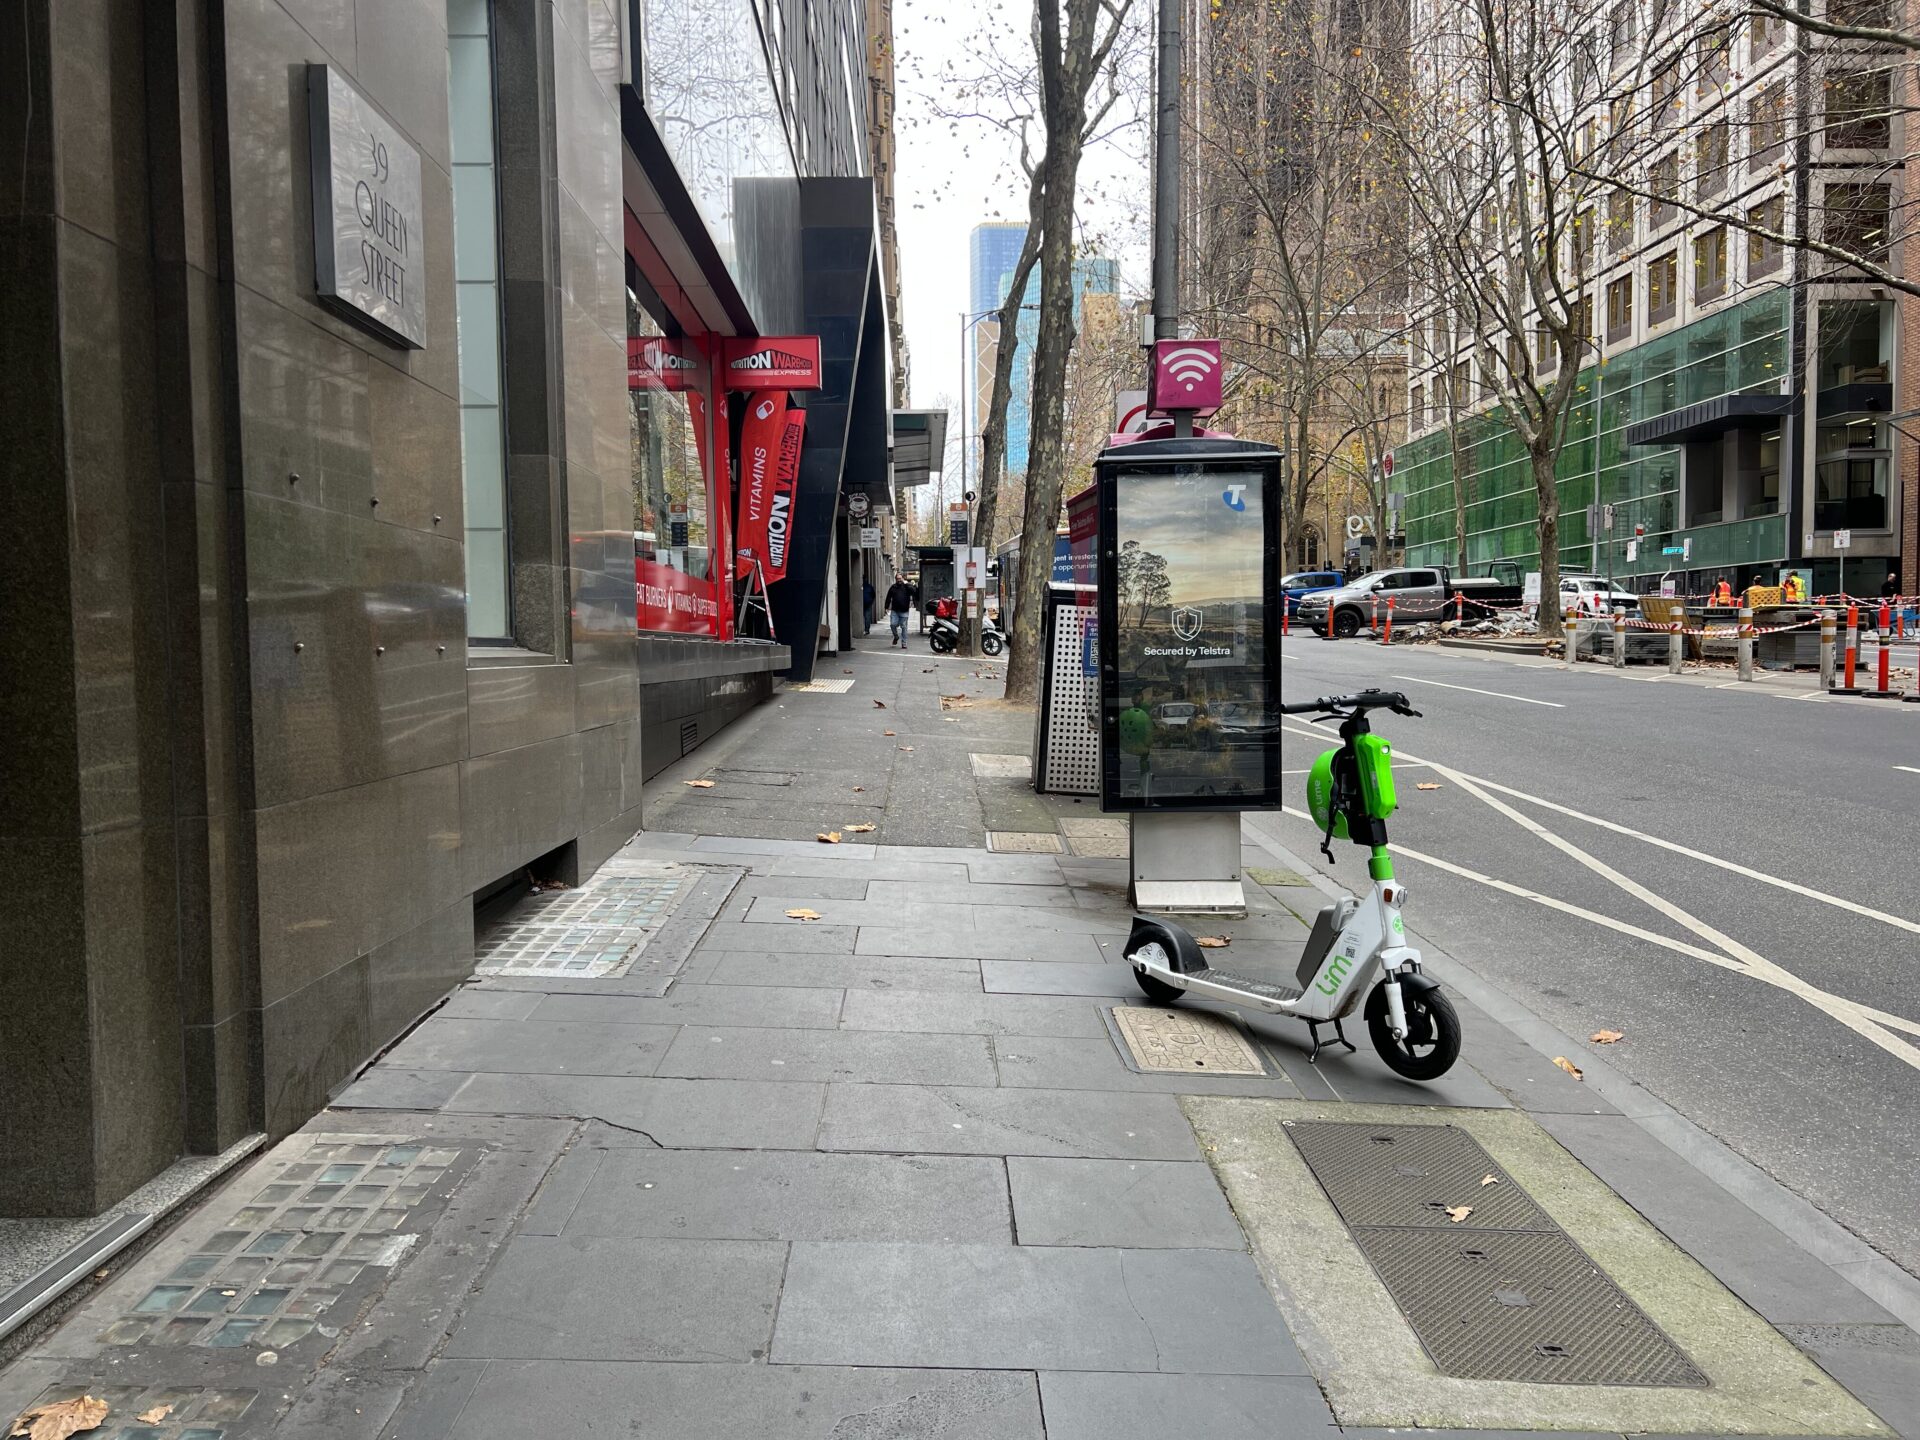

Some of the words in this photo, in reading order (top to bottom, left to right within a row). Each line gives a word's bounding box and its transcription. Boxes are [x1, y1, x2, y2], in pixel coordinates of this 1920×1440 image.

[369, 133, 388, 184] 39
[355, 180, 408, 258] QUEEN
[361, 239, 406, 309] STREET
[731, 350, 771, 369] NUTRITION
[771, 350, 811, 369] WAREHOUSE
[749, 445, 768, 521] VITAMINS
[776, 424, 801, 491] WAREHOUSE
[767, 494, 791, 567] NUTRITION
[636, 582, 645, 604] FAT
[645, 585, 667, 609] BURNERS
[675, 592, 692, 613] VITAMINS
[1144, 646, 1184, 656] Secured
[1185, 646, 1197, 657] by
[1198, 646, 1231, 656] Telstra
[1313, 779, 1324, 806] Lime
